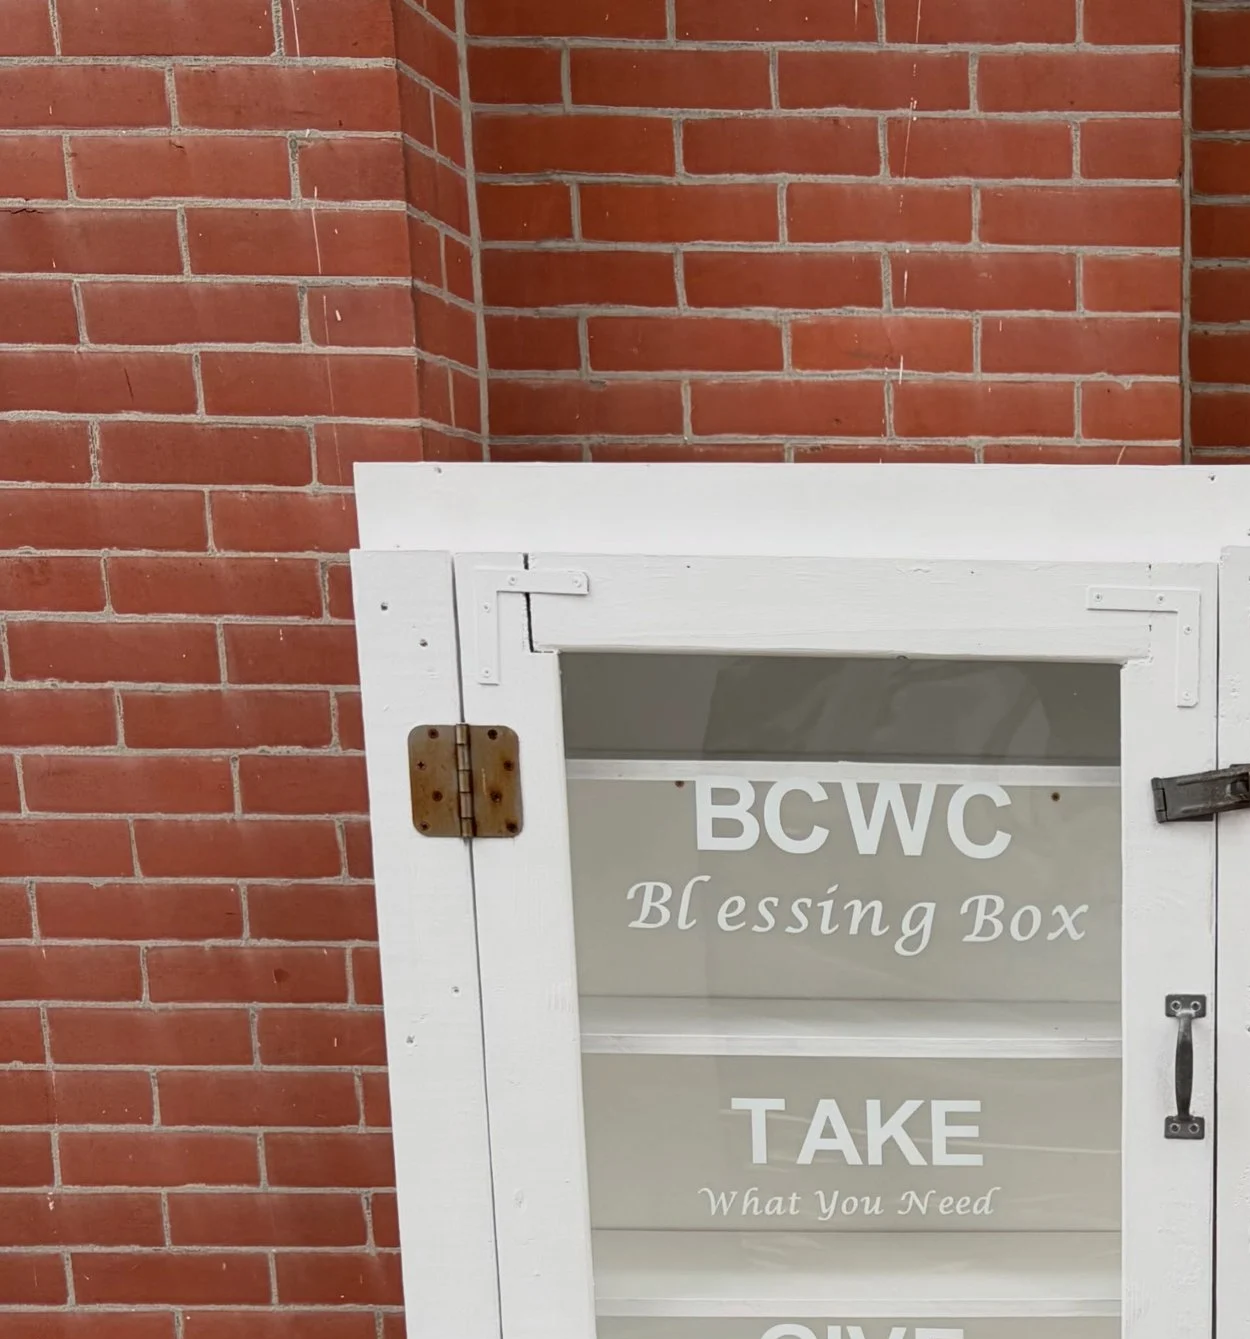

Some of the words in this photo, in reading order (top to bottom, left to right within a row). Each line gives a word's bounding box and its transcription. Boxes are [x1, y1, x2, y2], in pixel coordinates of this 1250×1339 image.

[692, 776, 1013, 860] BCWC
[627, 875, 936, 956] Blessing
[960, 894, 1089, 943] Box
[731, 1097, 984, 1167] TAKE
[697, 1187, 800, 1217] What
[813, 1188, 883, 1221] You
[897, 1187, 1001, 1216] Need
